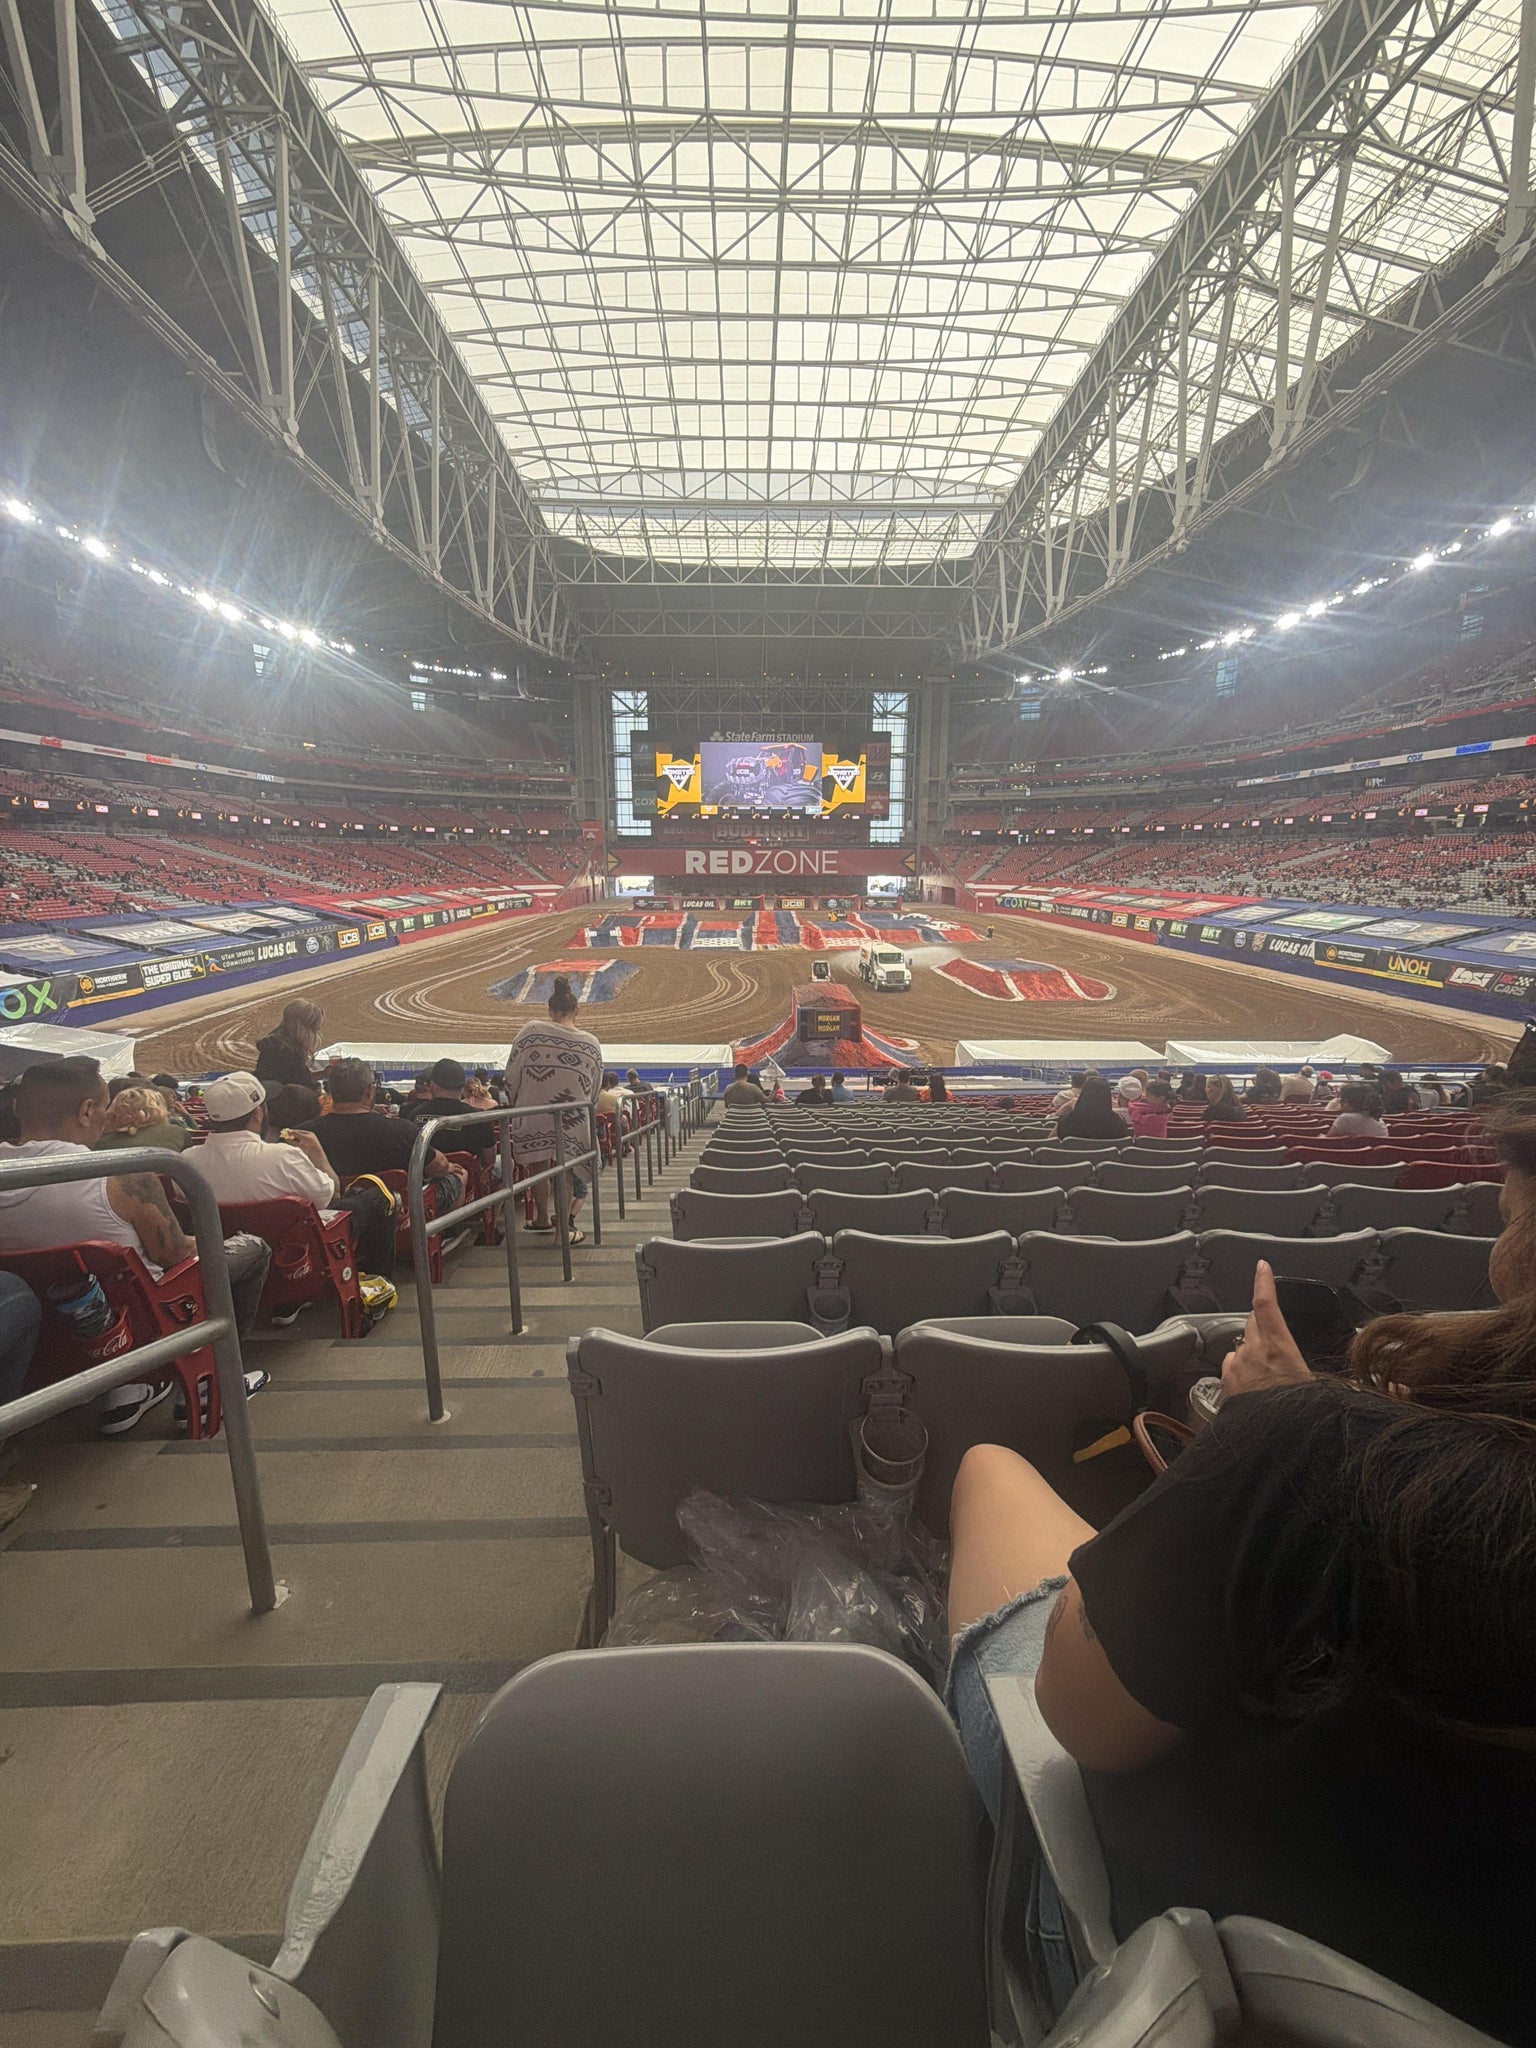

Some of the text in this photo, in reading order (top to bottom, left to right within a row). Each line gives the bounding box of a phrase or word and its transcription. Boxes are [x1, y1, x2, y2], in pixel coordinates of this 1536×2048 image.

[776, 733, 814, 742] STADIUM
[634, 798, 656, 806] COX
[716, 825, 752, 838] BUD
[704, 900, 715, 908] OIL
[783, 900, 803, 908] JCB
[369, 924, 386, 937] JCB
[1170, 921, 1188, 935] BKT
[1201, 926, 1222, 940] BKT
[340, 931, 359, 945] JCB
[257, 945, 284, 961] LUCAS
[285, 940, 299, 955] OIL
[1269, 939, 1299, 955] LUCAS
[220, 949, 255, 961] UTAH SPORTS
[142, 958, 194, 976] THE ORIGINAL
[222, 956, 256, 969] COMMISSION
[1388, 955, 1431, 977] UNOH
[145, 968, 192, 987] SUPER GLUE
[1494, 983, 1527, 997] CARS
